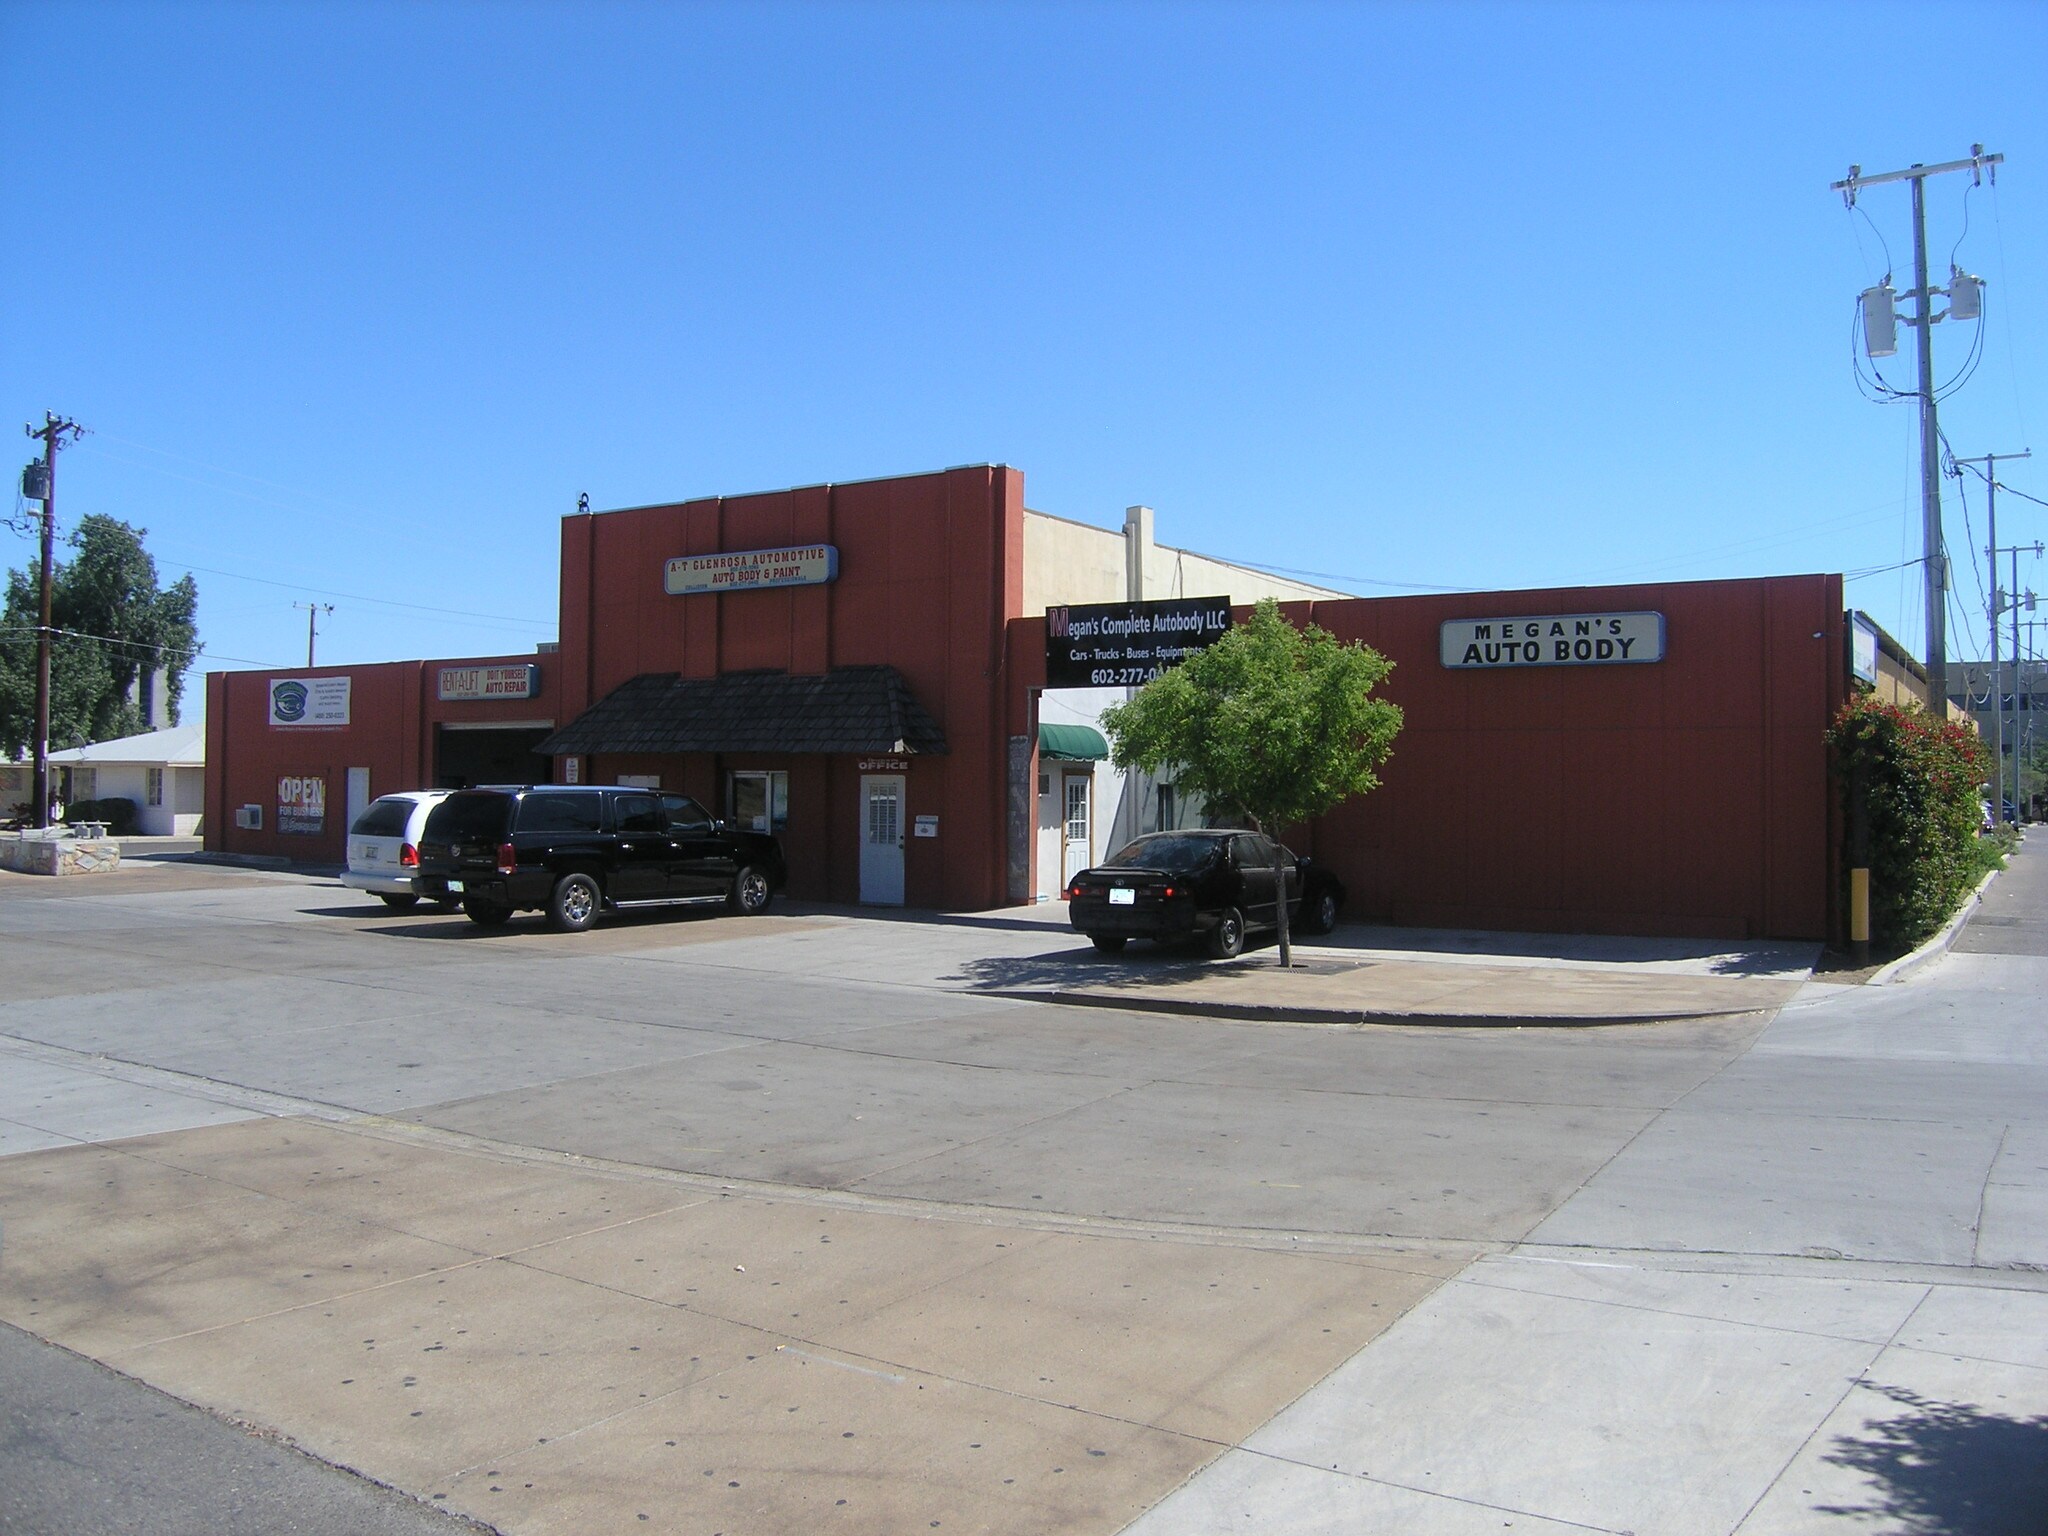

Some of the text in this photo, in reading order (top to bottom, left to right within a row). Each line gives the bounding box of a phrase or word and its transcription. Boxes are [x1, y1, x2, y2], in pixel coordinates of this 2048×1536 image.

[670, 560, 688, 573] A-T
[693, 556, 747, 571] GLENROSA
[752, 548, 825, 565] AUTOMOTIVE
[712, 571, 736, 584] AUTO
[738, 569, 761, 582] BODY
[763, 568, 770, 579] &
[773, 566, 801, 578] PAINT
[1050, 608, 1226, 640] Megan's Complete Autobody LLC
[1474, 618, 1622, 640] MEGAN'S
[1070, 648, 1087, 661] Cars
[1094, 647, 1120, 660] Trucks
[1126, 647, 1149, 660] Buses
[1462, 638, 1636, 664] AUTO BODY
[500, 668, 527, 680] YOURSELF
[485, 681, 503, 694] AUTO
[504, 681, 527, 693] REPAIR
[859, 761, 908, 770] OFFICE
[281, 778, 323, 803] OPEN
[280, 805, 325, 817] FOR BUSINESS
